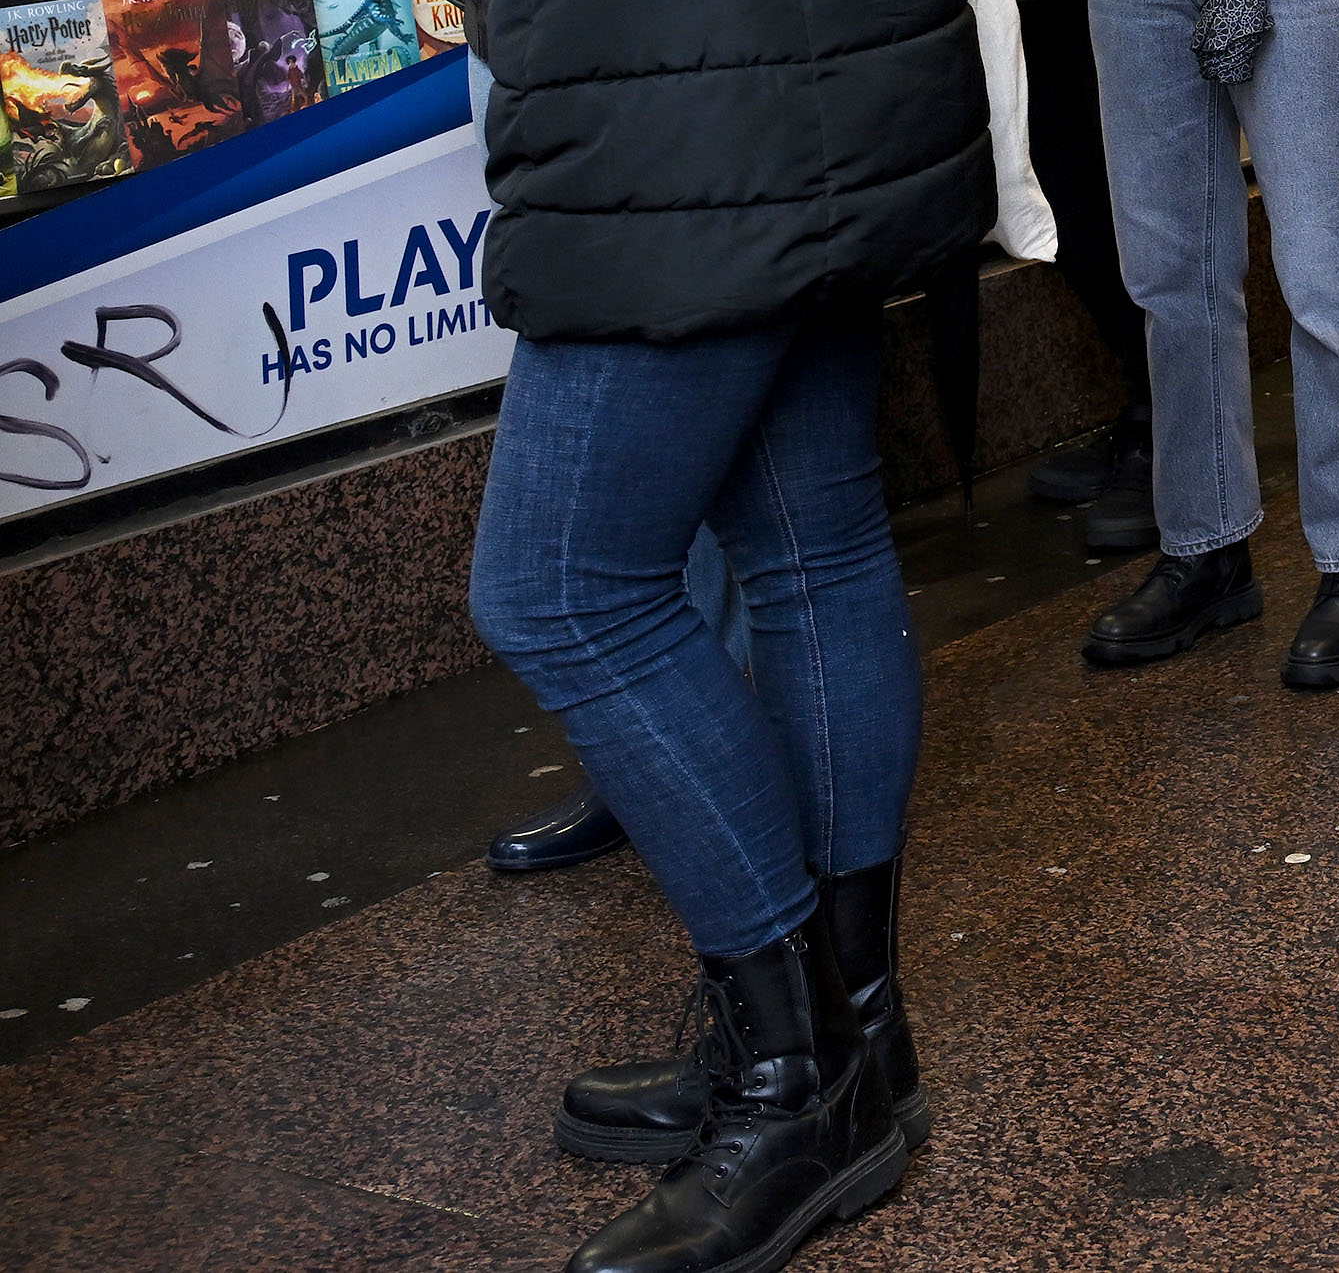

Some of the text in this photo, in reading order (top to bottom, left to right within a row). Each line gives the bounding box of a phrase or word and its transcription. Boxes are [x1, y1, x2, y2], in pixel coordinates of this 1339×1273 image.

[7, 0, 86, 23] J.K. ROWLING
[6, 16, 92, 53] Harry Potter
[323, 53, 403, 88] PLAMENA
[287, 209, 491, 332] PLAY
[262, 299, 492, 386] HAS NO LIMIT
